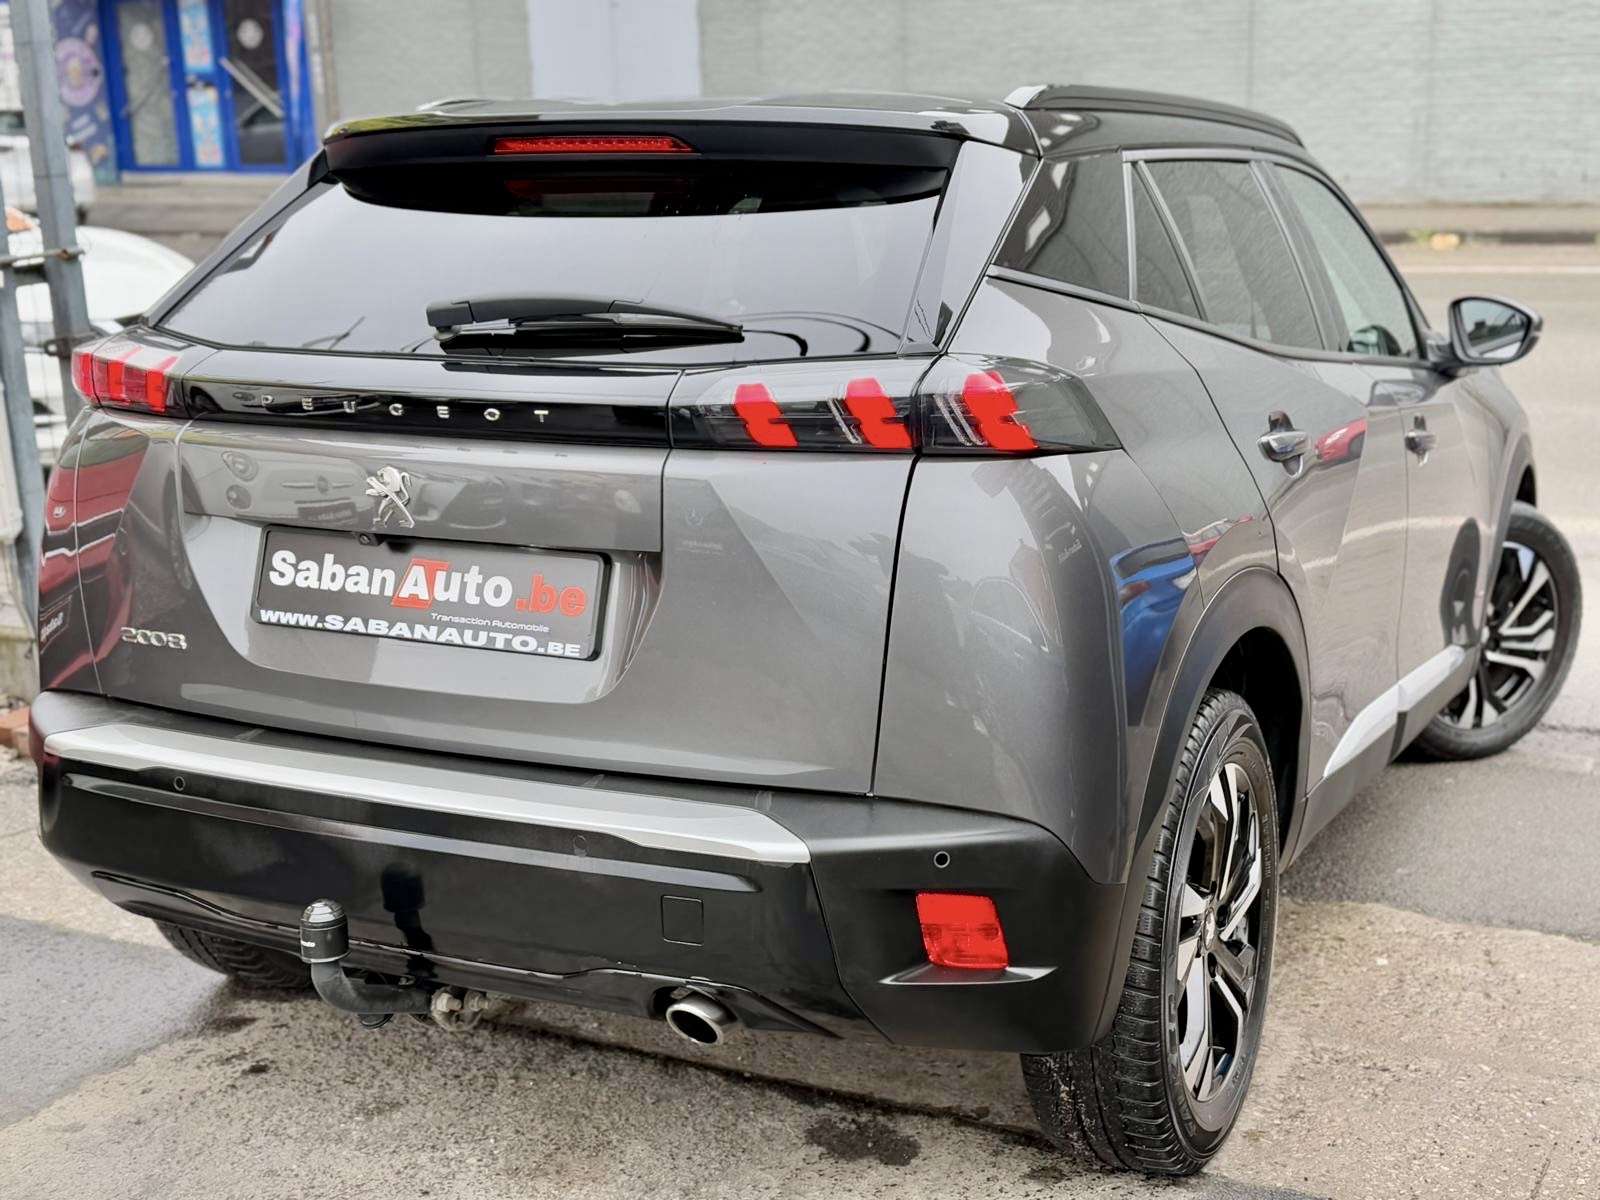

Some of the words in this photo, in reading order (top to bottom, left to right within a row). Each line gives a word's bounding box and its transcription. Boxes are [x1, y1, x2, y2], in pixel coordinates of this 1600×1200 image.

[264, 395, 550, 423] PEUGEOT
[259, 608, 581, 657] www.SABANAUTO.BE
[430, 612, 492, 627] Transaction
[492, 620, 551, 633] Automobile
[120, 626, 188, 650] 2008
